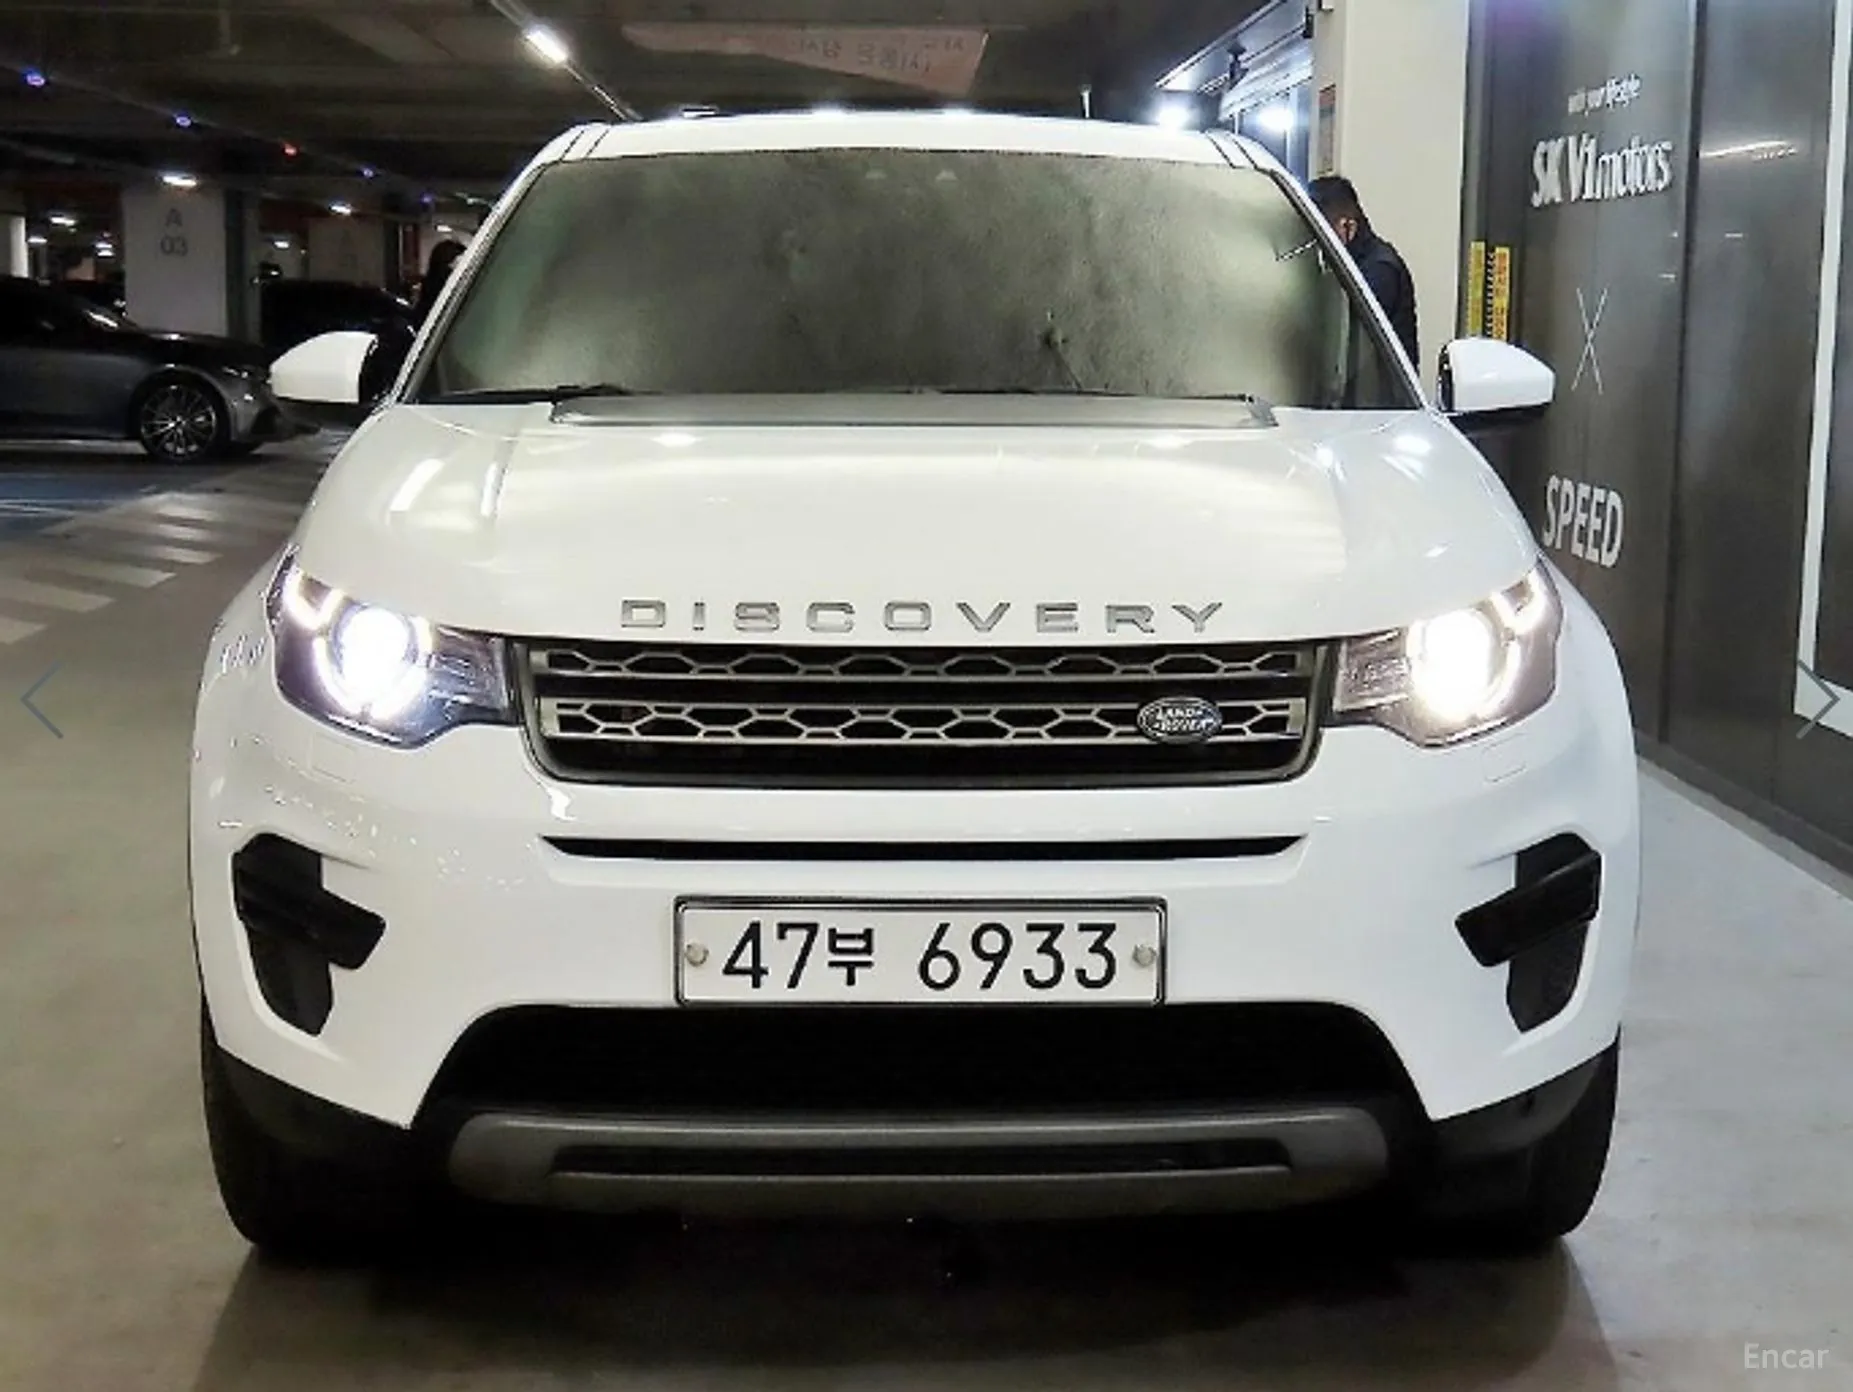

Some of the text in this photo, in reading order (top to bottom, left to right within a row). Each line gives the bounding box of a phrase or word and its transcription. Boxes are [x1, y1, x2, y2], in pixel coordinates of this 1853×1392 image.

[1531, 139, 1565, 208] SK
[164, 207, 183, 228] A
[1543, 474, 1624, 568] SPEED
[620, 600, 1223, 634] DISCOVERY
[721, 919, 1118, 991] 47부 6933
